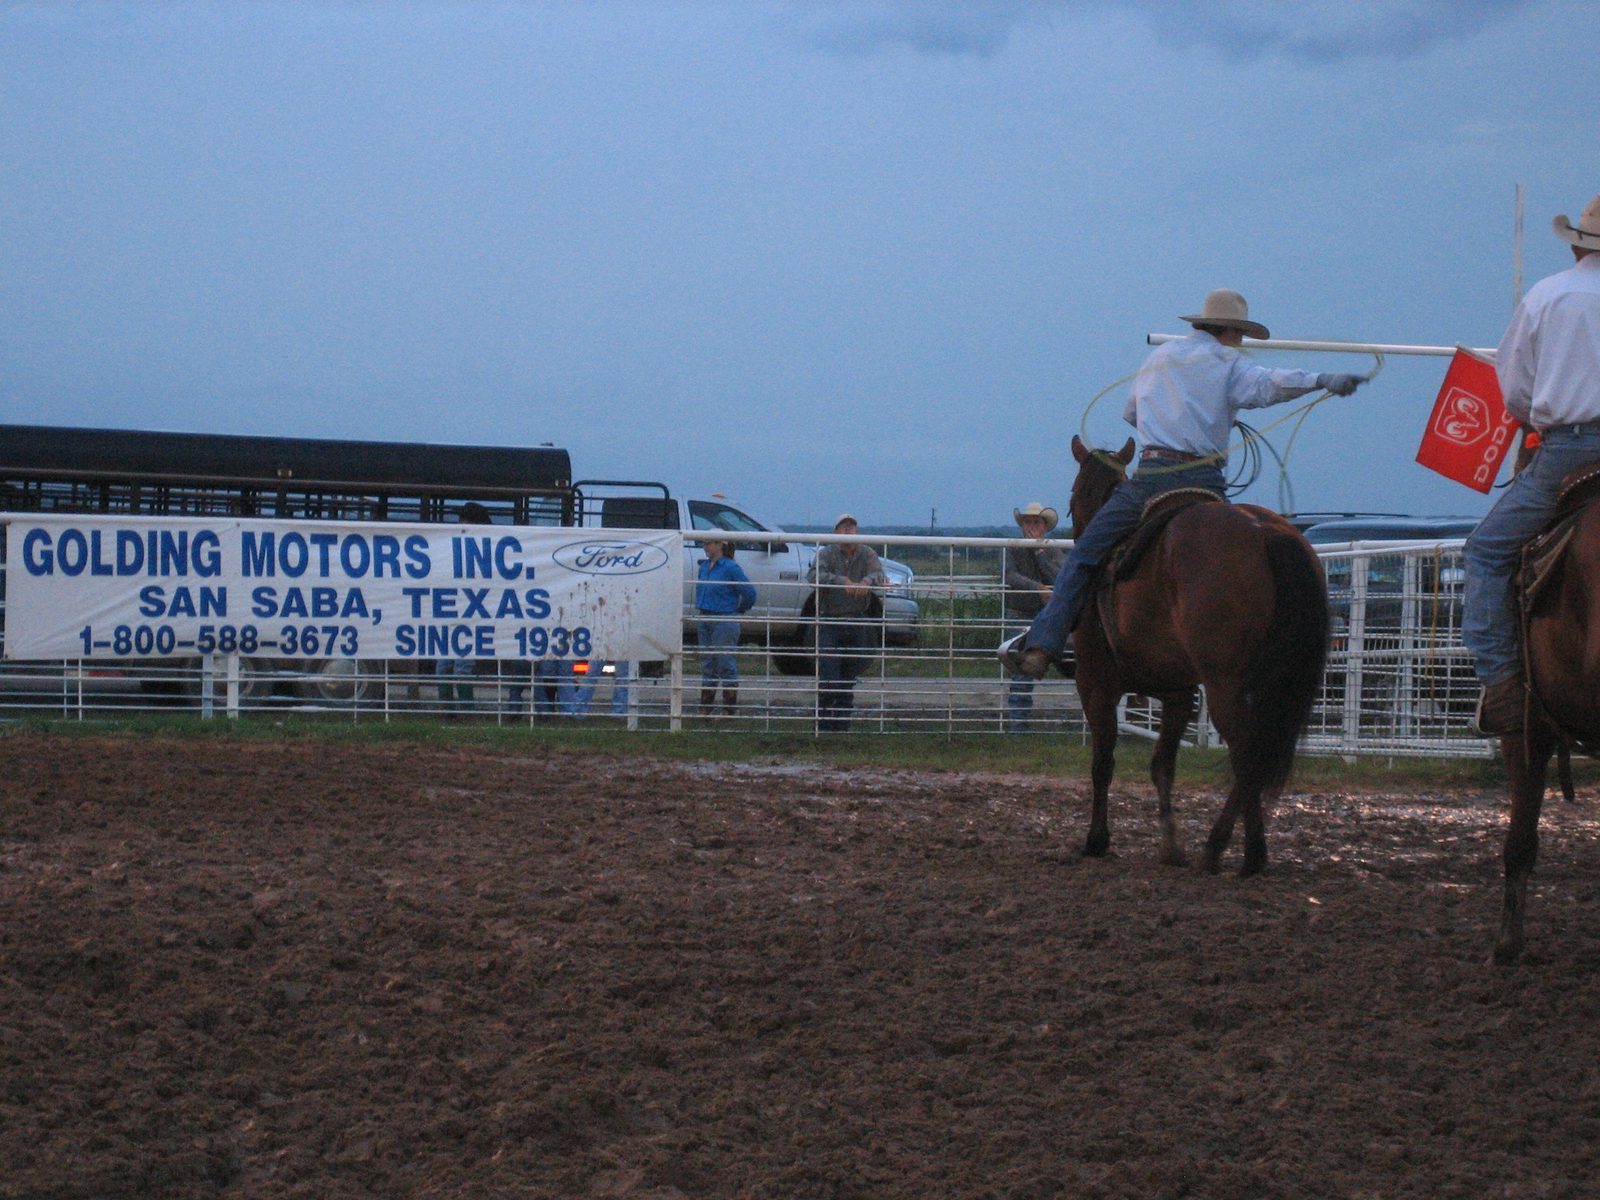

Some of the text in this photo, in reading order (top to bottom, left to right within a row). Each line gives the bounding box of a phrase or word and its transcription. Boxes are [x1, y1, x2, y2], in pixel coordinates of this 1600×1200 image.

[23, 528, 535, 580] GOLDING MOTORS INC.
[575, 544, 644, 568] Ford
[139, 586, 551, 625] SAN SABA, TEXAS
[395, 625, 496, 656] SINCE
[514, 626, 591, 657] 1938
